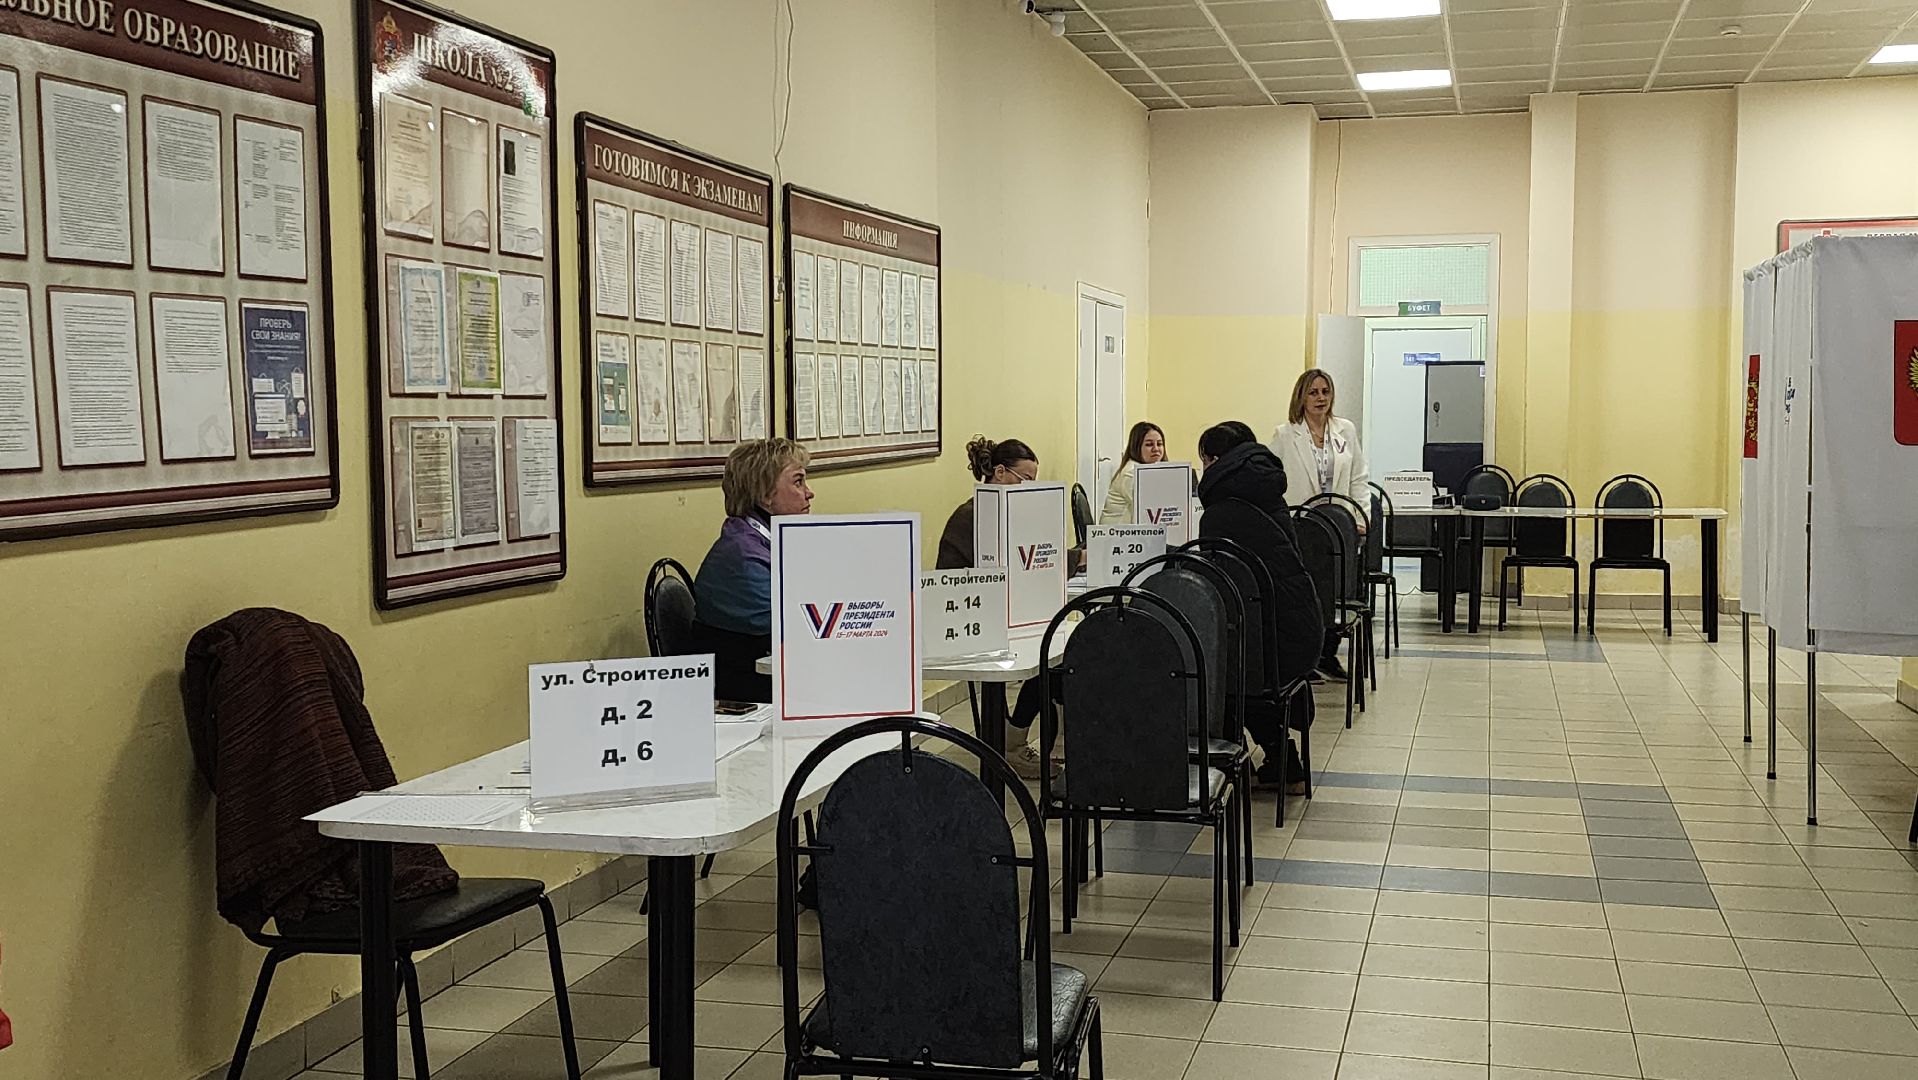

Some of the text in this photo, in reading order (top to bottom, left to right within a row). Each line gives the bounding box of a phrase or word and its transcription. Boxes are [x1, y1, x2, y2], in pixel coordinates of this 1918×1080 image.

[0, 0, 300, 80] ЬНОЕ ОБРАЗОВАНИЕ
[413, 32, 487, 83] ШКОЛА
[593, 143, 763, 215] ГОТОВИМСЯ К ЭКЗАМЕНАМ
[843, 220, 898, 249] ИНФОРМАЦИЯ
[1091, 527, 1165, 538] ул. Строителей
[1112, 543, 1143, 555] д. 20
[1112, 563, 1141, 575] д. 2
[921, 572, 1006, 589] ул. Строителей
[847, 601, 884, 610] ВЫБОРЫ
[945, 595, 981, 613] д. 14
[843, 610, 895, 620] ПРЕЗИДЕНТА
[839, 621, 873, 630] РОССИИ
[852, 630, 873, 638] МАРТА
[945, 622, 981, 640] д. 18
[541, 662, 710, 691] ул. Строителей
[601, 699, 653, 725] д. 2
[601, 741, 654, 767] д. 6
